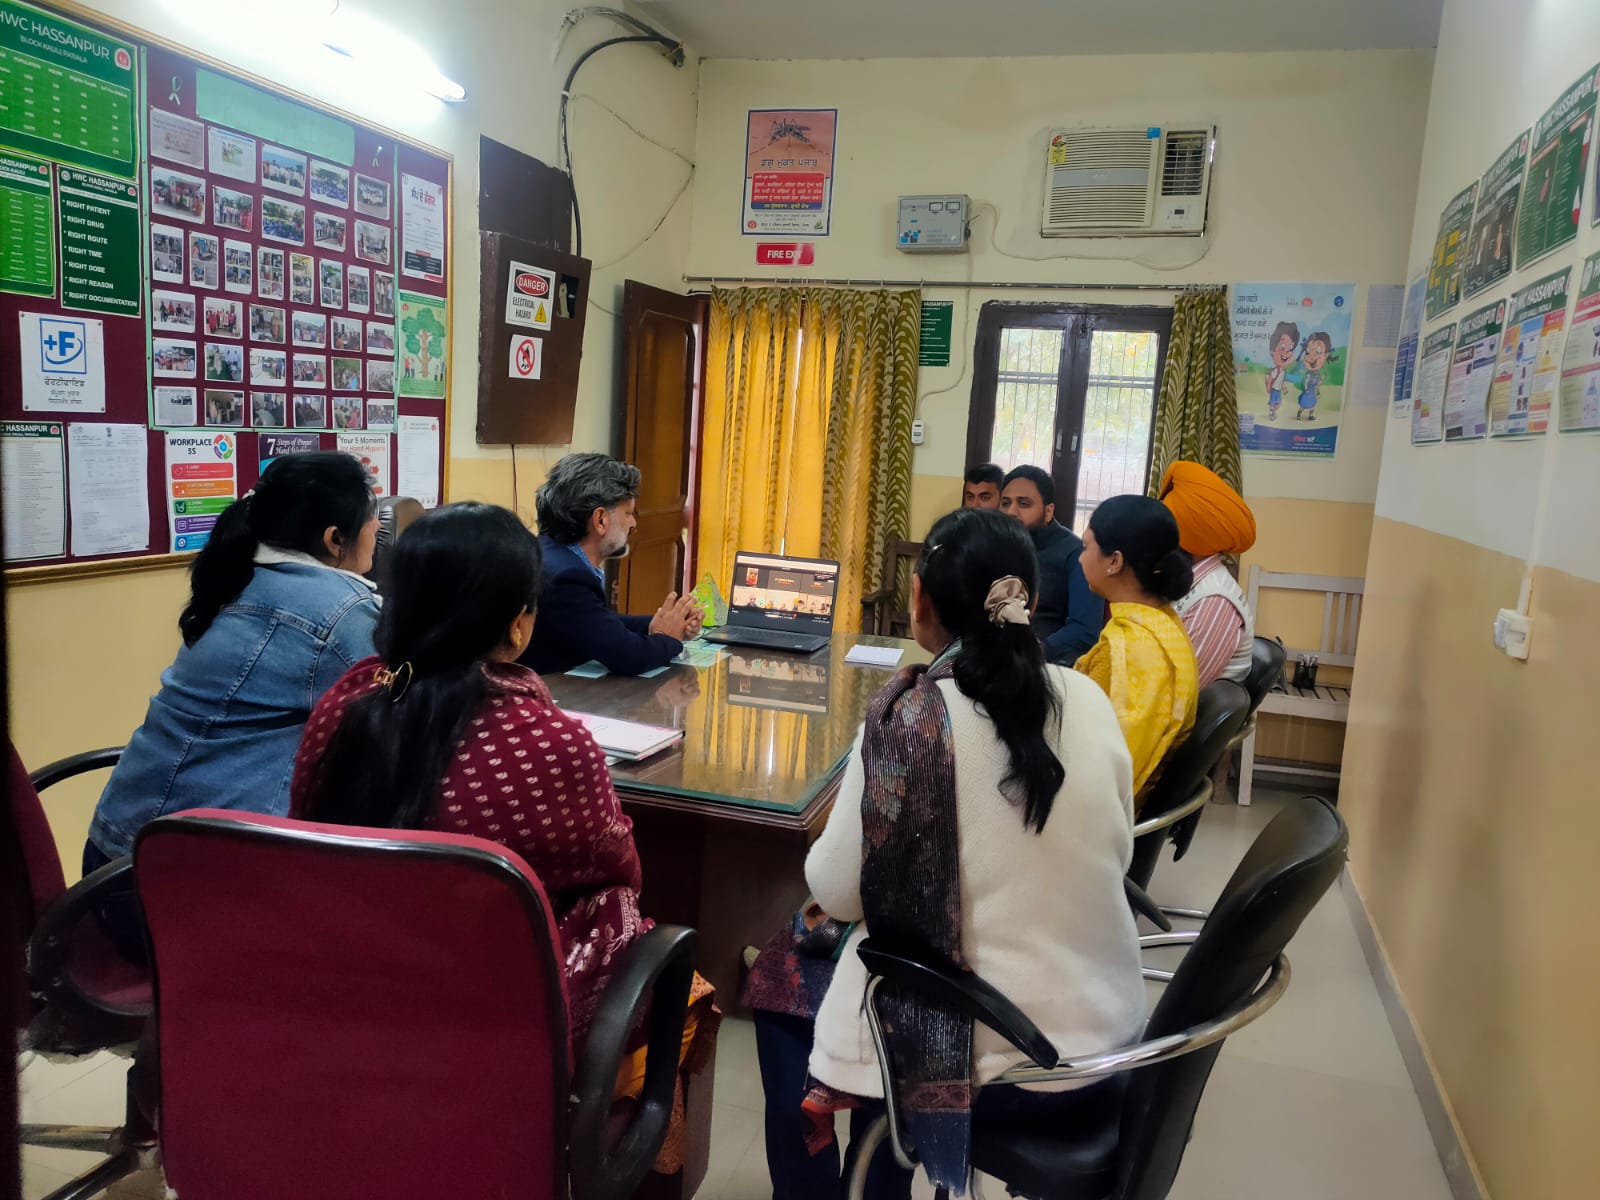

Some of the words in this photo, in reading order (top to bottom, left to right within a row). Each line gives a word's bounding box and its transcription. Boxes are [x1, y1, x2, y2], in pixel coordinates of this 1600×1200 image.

[32, 21, 110, 60] HASSANPUR
[72, 172, 88, 182] HWC
[88, 176, 126, 192] HASSANPUR
[66, 200, 85, 210] RIGHT
[86, 204, 111, 216] PATIENT
[67, 215, 86, 225] RIGHT
[87, 220, 105, 229] DRUG
[68, 231, 86, 240] RIGHT
[87, 235, 108, 244] ROUTE
[68, 246, 87, 255] RIGHT
[88, 250, 103, 258] TIME
[767, 250, 784, 258] FIRE
[69, 261, 87, 270] RIGHT
[88, 265, 106, 273] DOSE
[69, 277, 87, 285] RIGHT
[88, 280, 114, 289] REASON
[518, 277, 546, 291] DANGER
[1526, 276, 1566, 305] HASSANPUR
[69, 292, 88, 300] RIGHT
[88, 295, 138, 307] DOCUMENTATION
[512, 297, 535, 309] ELECTRICAL
[267, 438, 276, 455] 7
[276, 438, 290, 448] Steps
[290, 437, 298, 446] of
